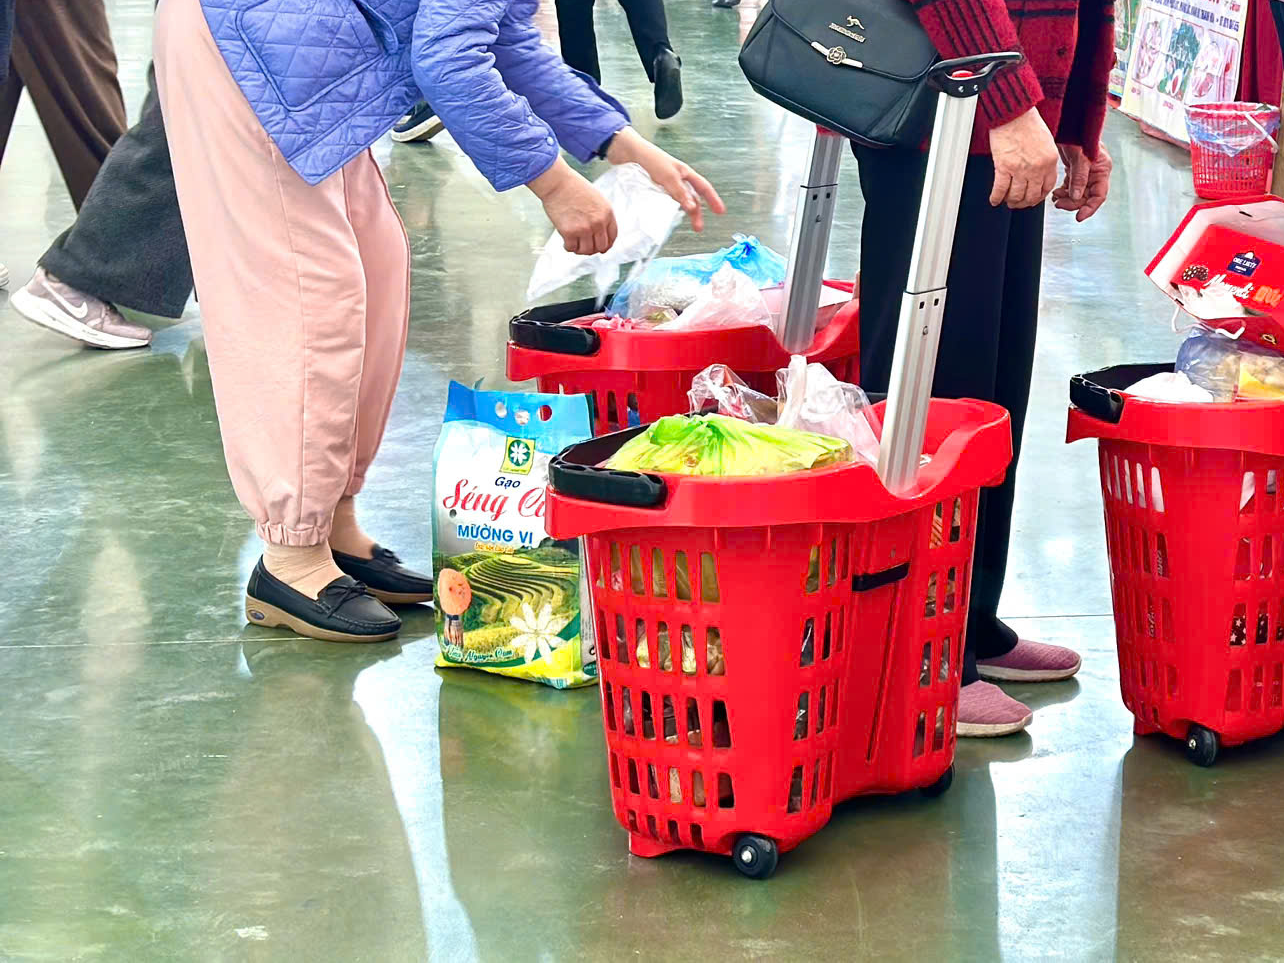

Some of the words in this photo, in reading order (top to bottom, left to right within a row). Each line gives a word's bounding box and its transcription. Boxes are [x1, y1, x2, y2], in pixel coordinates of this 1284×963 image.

[494, 476, 521, 490] Gạo
[443, 478, 509, 522] Séng
[458, 523, 514, 543] MƯỜNG
[519, 531, 533, 544] VI
